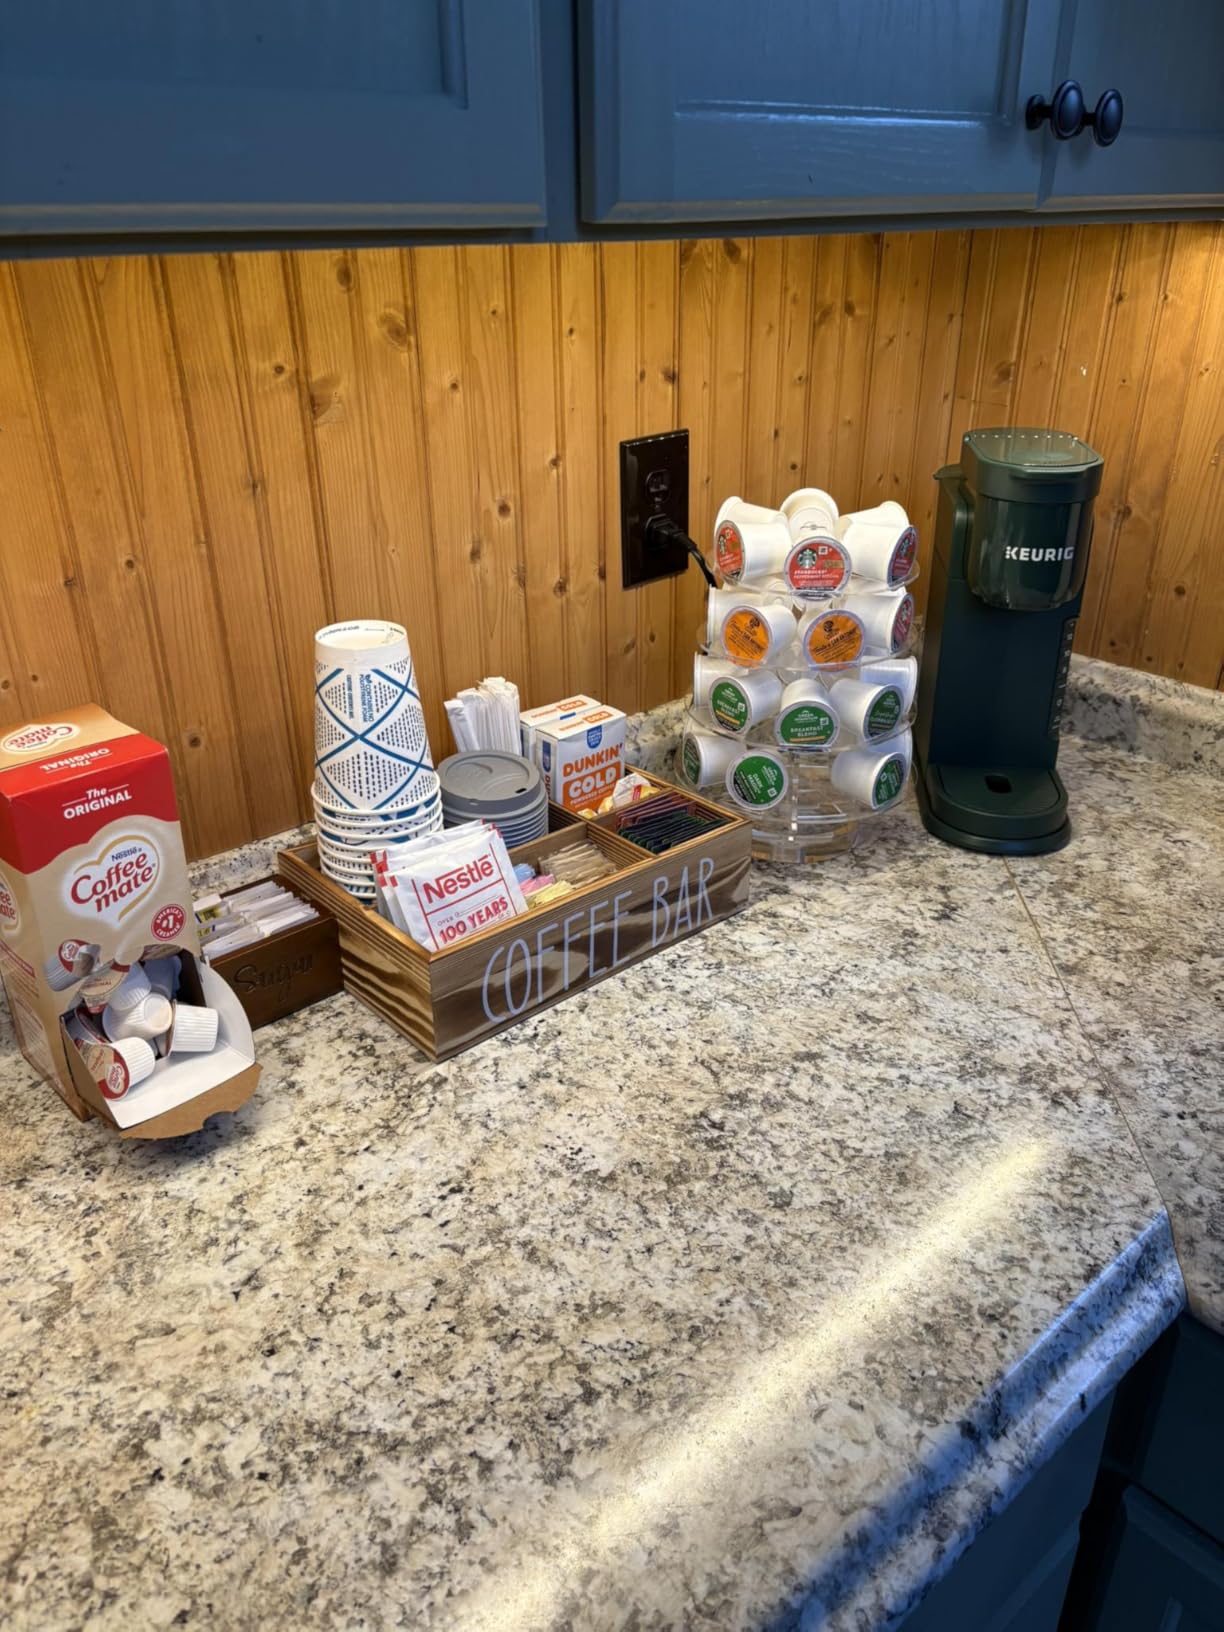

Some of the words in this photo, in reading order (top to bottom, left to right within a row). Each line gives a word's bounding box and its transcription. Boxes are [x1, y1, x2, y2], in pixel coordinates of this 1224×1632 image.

[1004, 546, 1075, 561] KEURIG
[39, 748, 110, 771] ORIGINAL
[562, 742, 624, 778] DUNKIN'
[86, 787, 107, 799] The
[568, 766, 617, 798] COLD
[63, 790, 132, 819] ORIGINAL
[71, 852, 148, 904] Coffee
[95, 866, 152, 913] mate
[439, 920, 467, 944] 100
[467, 896, 508, 929] YEARS
[481, 890, 633, 1025] COFFEE
[651, 857, 715, 948] BAR
